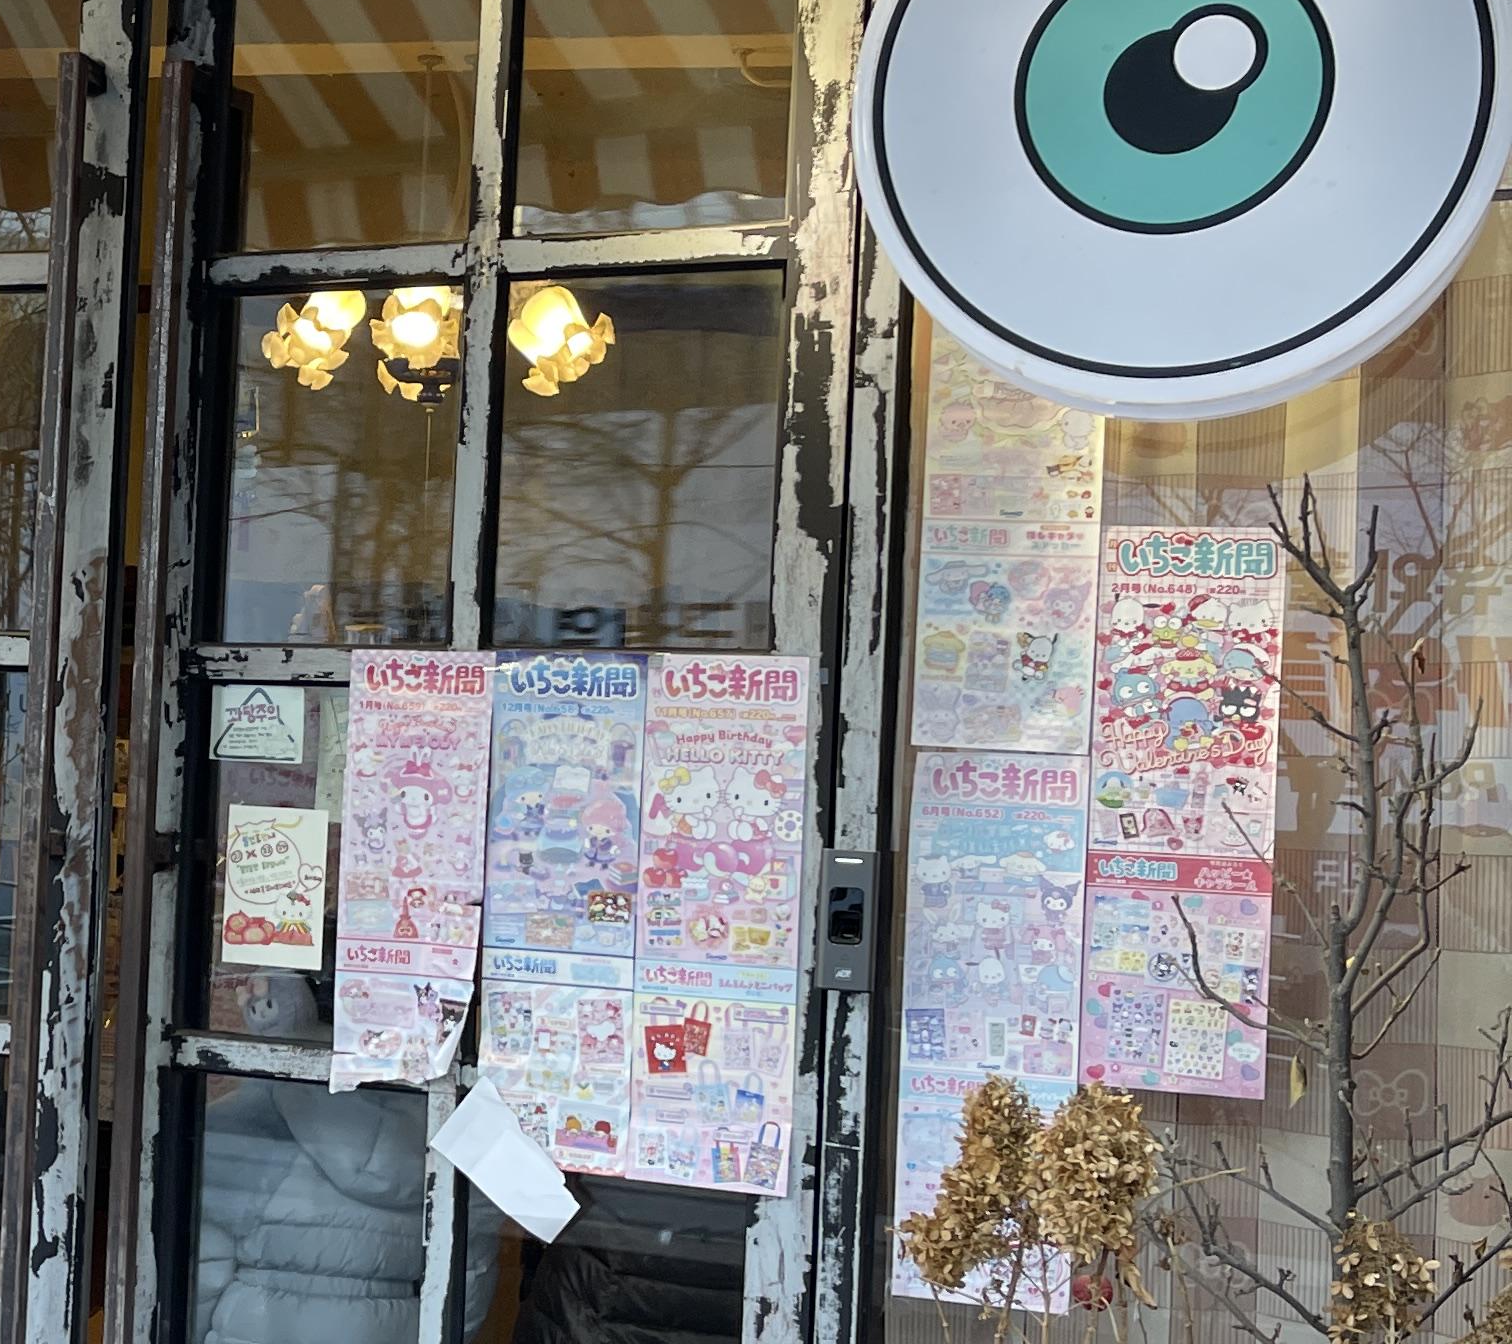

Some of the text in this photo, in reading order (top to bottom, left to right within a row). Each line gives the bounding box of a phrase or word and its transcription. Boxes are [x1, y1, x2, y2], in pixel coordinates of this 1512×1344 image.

[1121, 535, 1273, 576] いちご新聞
[366, 658, 485, 695] いちご新聞
[511, 659, 637, 698] いちご新聞
[665, 662, 798, 702] いちご新聞
[676, 730, 773, 748] Happy Birthday
[1101, 720, 1170, 750] Happy
[1218, 727, 1272, 767] Day
[666, 748, 785, 766] HELLO KITTY
[933, 760, 1078, 803] いちご新聞
[1099, 856, 1177, 880] いちご新聞
[347, 944, 411, 965] いちご新聞
[493, 953, 558, 974] いちご新聞
[645, 965, 713, 987] いちご新聞
